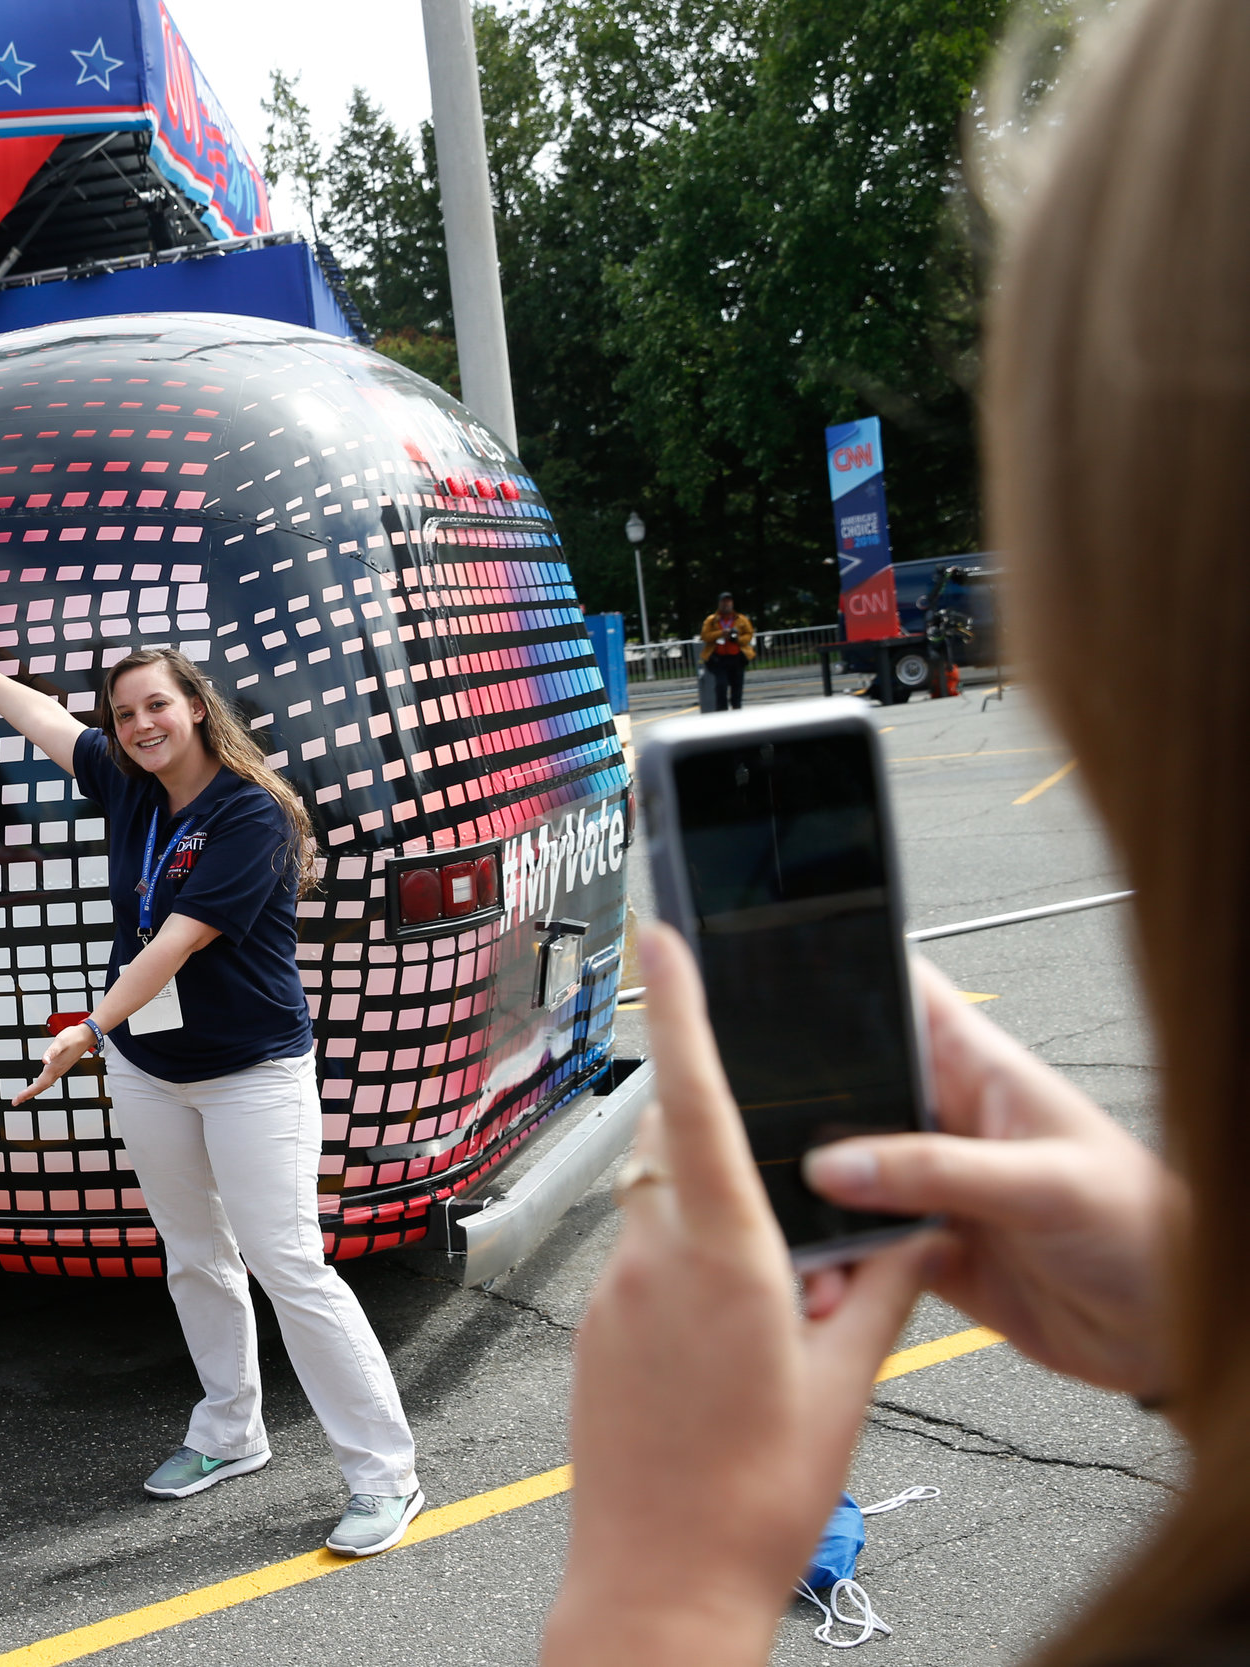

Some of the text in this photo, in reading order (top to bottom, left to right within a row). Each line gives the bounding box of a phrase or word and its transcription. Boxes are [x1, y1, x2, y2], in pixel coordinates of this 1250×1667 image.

[833, 443, 873, 472] CNN
[841, 521, 879, 539] CHOICE
[849, 589, 888, 616] CNN
[500, 799, 625, 931] #MyVote
